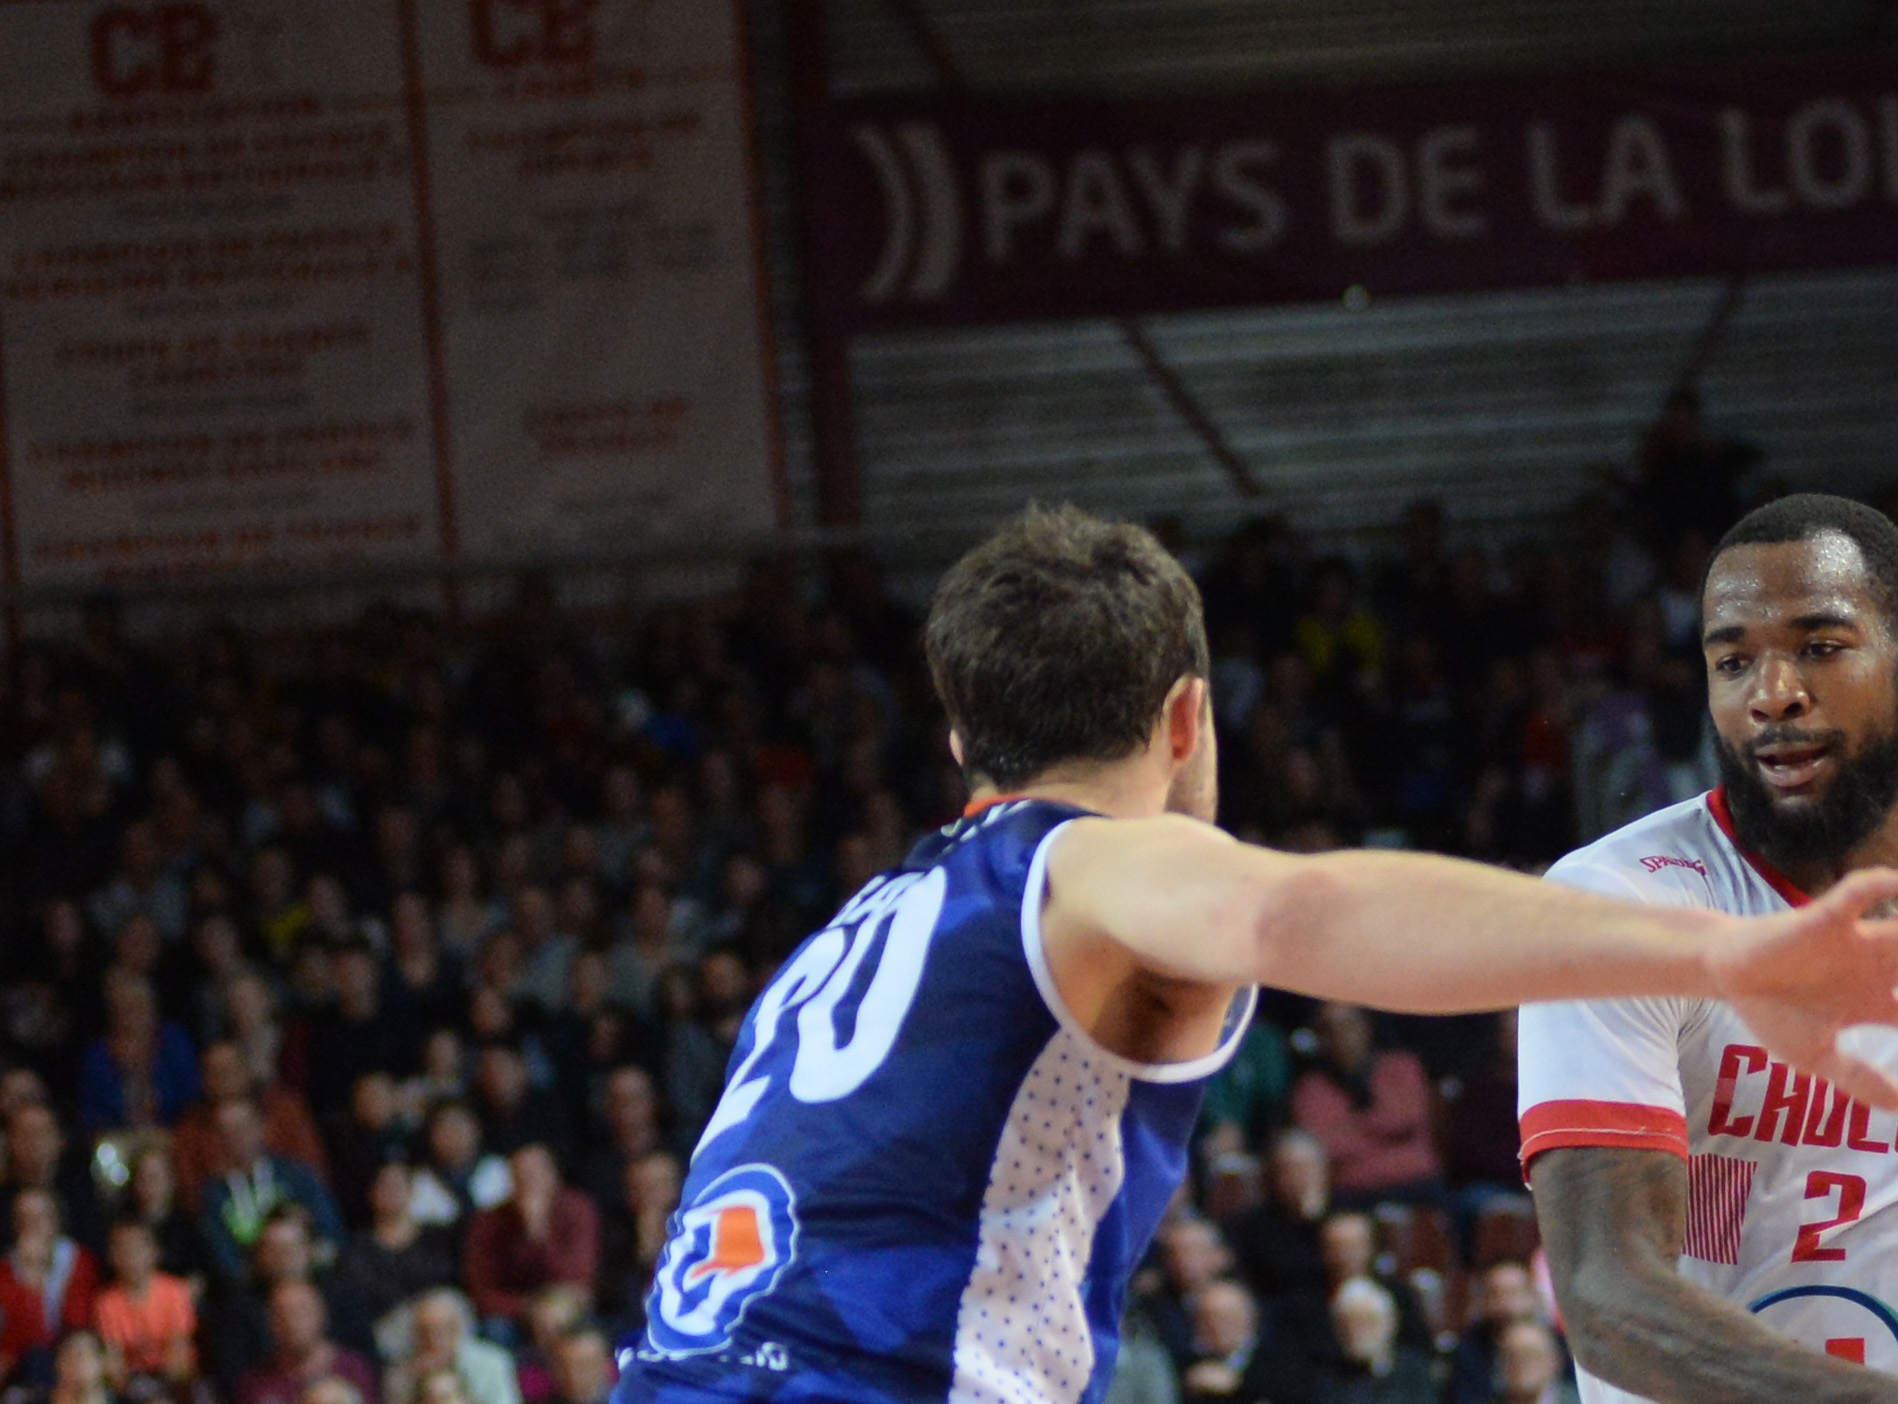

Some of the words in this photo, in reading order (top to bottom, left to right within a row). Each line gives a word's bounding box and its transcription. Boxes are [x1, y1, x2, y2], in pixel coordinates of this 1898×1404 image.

[980, 139, 1287, 262] PAYS
[1326, 126, 1487, 247] DE
[1525, 112, 1687, 229] LA
[1791, 1171, 1867, 1262] 2
